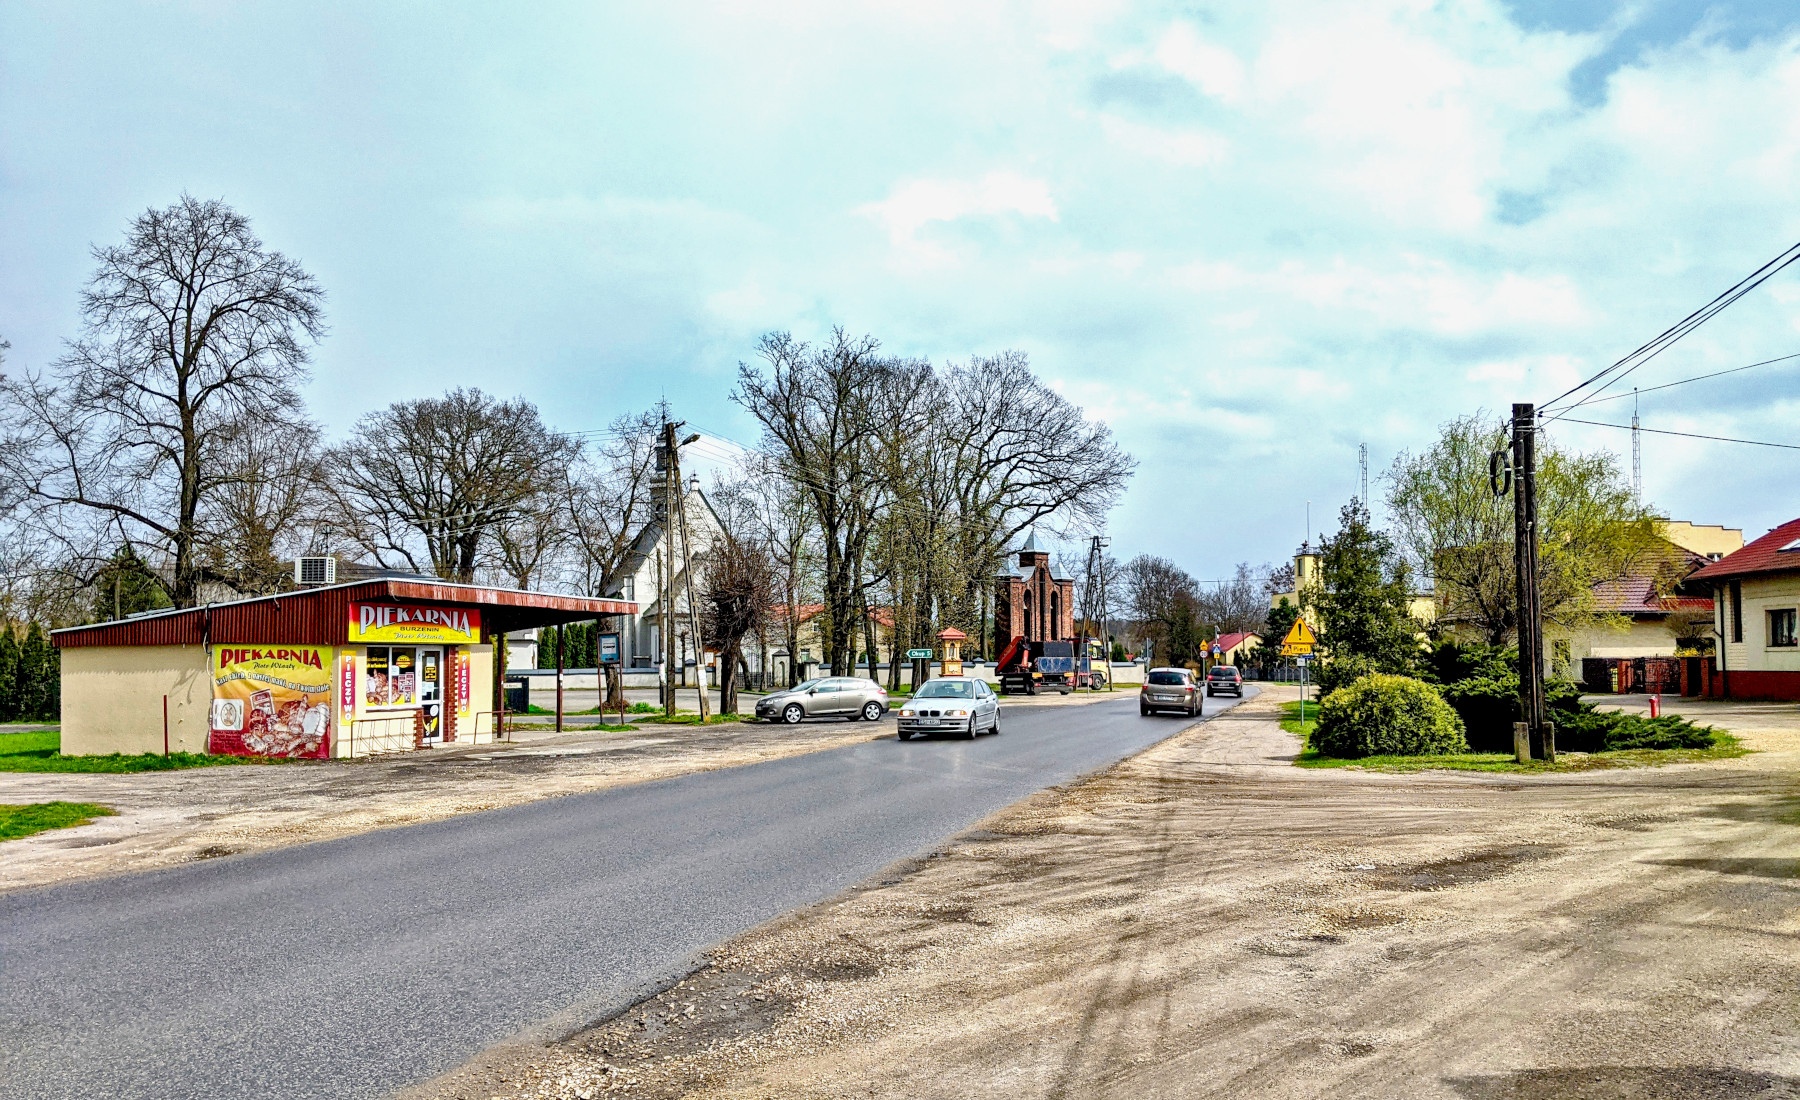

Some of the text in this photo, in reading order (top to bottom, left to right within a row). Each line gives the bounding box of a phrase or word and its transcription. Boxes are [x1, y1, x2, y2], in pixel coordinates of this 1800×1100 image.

[360, 606, 472, 638] PIEKARNIA
[220, 648, 322, 670] PIEKARNIA
[911, 650, 925, 658] Okup
[343, 655, 354, 721] PIECZYWO
